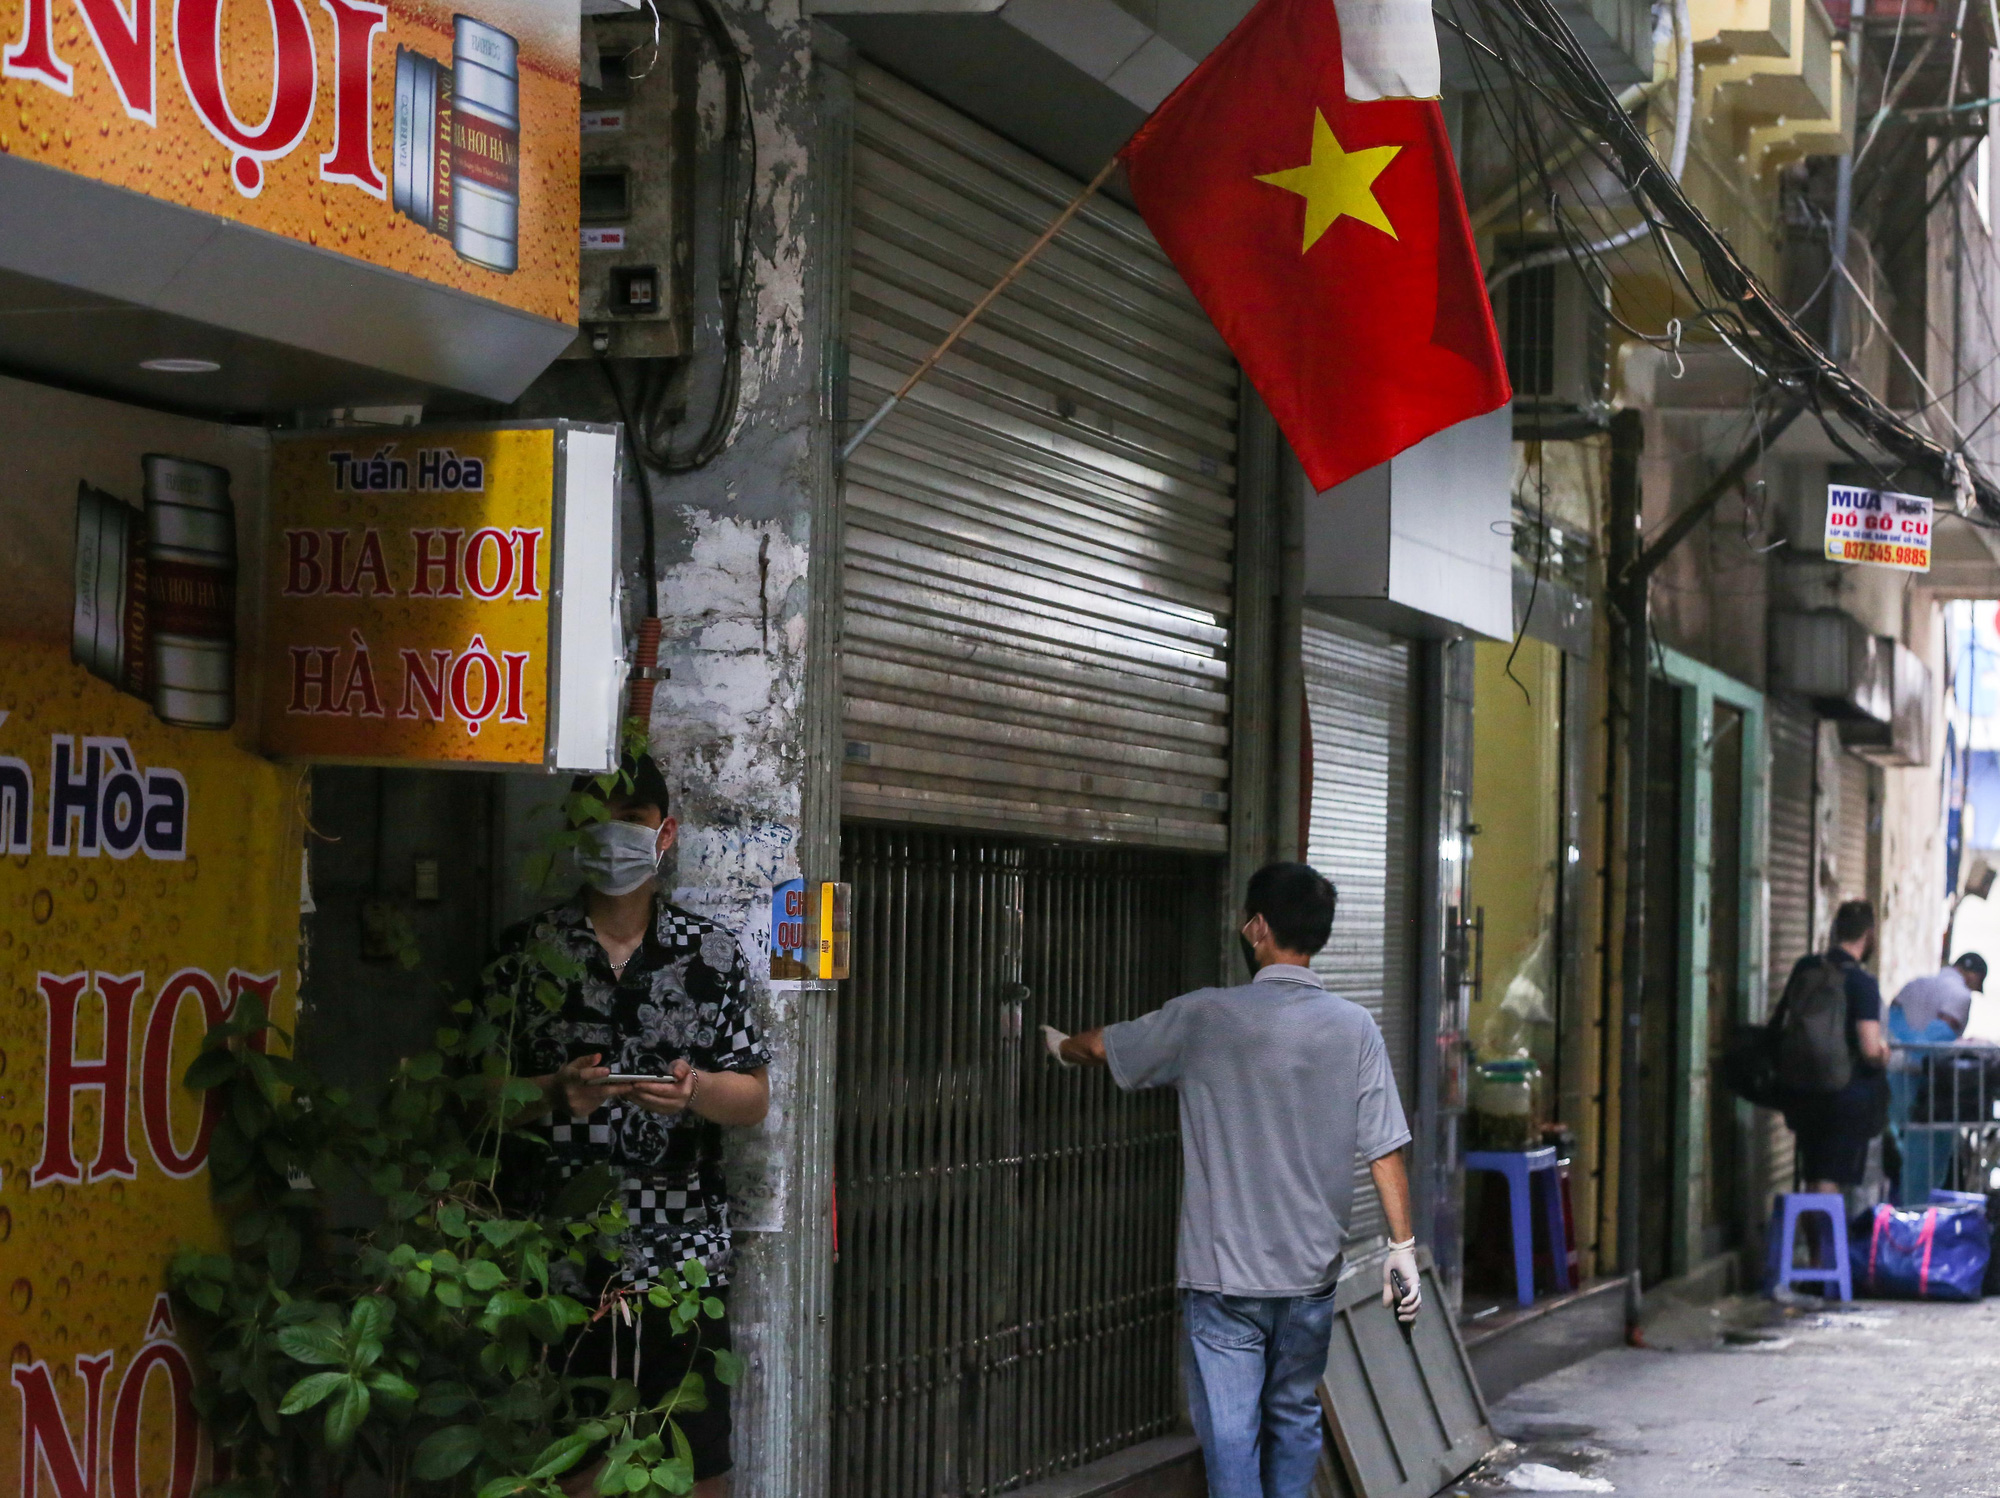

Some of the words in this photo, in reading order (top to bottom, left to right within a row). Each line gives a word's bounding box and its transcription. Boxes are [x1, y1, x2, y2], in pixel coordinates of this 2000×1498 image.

[330, 443, 408, 491] Tuấn
[417, 447, 484, 491] Hòa
[1831, 490, 1882, 511] MUA
[283, 527, 395, 596] BIA
[409, 527, 542, 600] HƠI
[1844, 541, 1927, 566] 037.545.9885
[287, 628, 385, 717] HÀ
[398, 633, 529, 737] NỘI
[48, 734, 188, 860] Hòa
